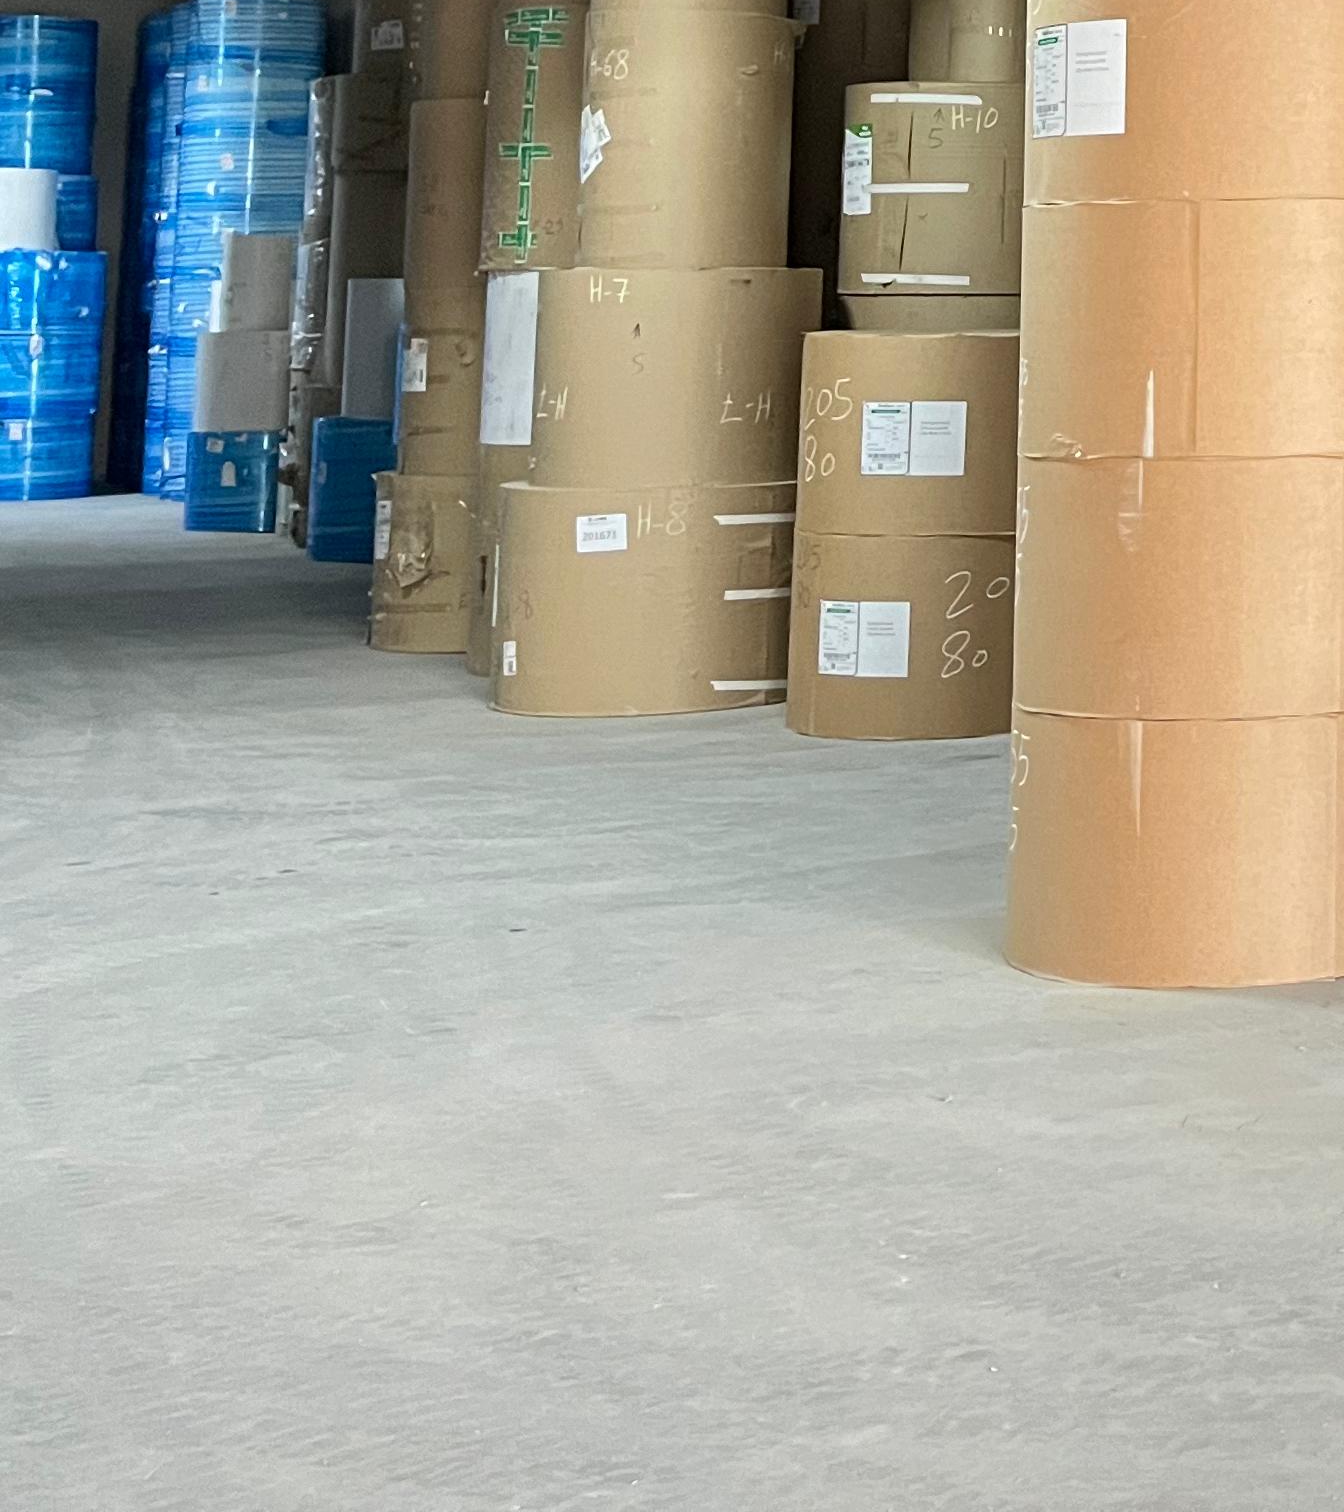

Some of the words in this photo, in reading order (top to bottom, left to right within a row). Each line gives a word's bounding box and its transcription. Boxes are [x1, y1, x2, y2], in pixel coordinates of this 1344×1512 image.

[952, 105, 999, 134] H-10
[589, 275, 631, 304] H-7
[803, 435, 836, 482] 80
[637, 500, 687, 539] H-8
[945, 570, 1010, 619] 20
[941, 630, 988, 678] 80
